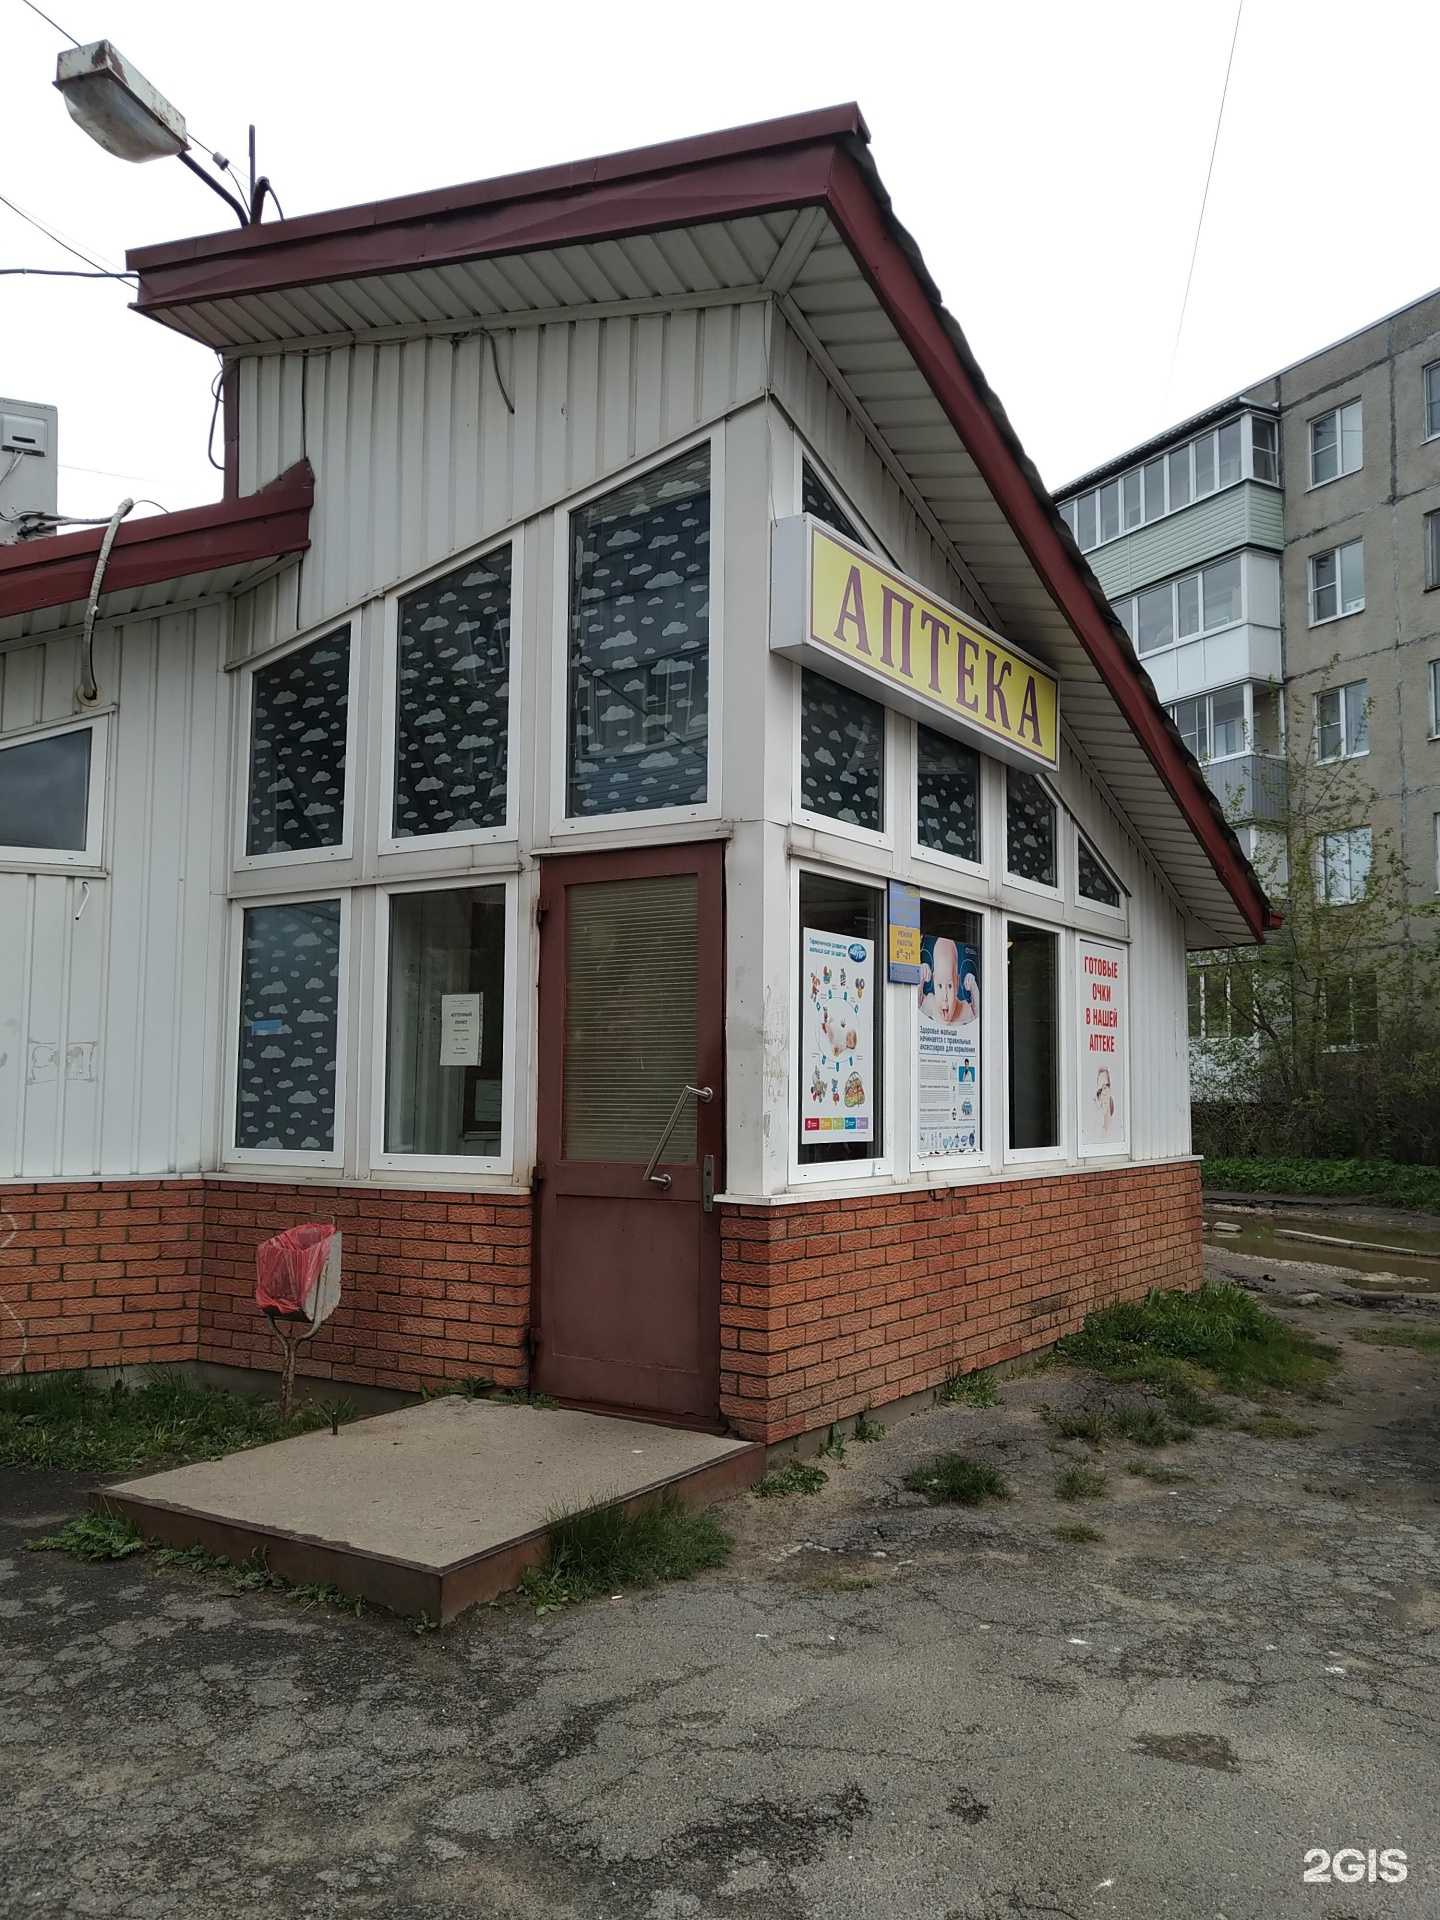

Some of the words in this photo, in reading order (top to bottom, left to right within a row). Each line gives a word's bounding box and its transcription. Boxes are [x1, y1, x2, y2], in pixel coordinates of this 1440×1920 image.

[833, 565, 1042, 747] АПТЕКА
[1084, 956, 1118, 978] ГОТОВЫЕ
[1092, 983, 1111, 1002] ОЧКИ
[1085, 1007, 1091, 1025] В
[1093, 1008, 1118, 1028] НАШЕЙ
[1089, 1034, 1115, 1053] АПТЕКЕ
